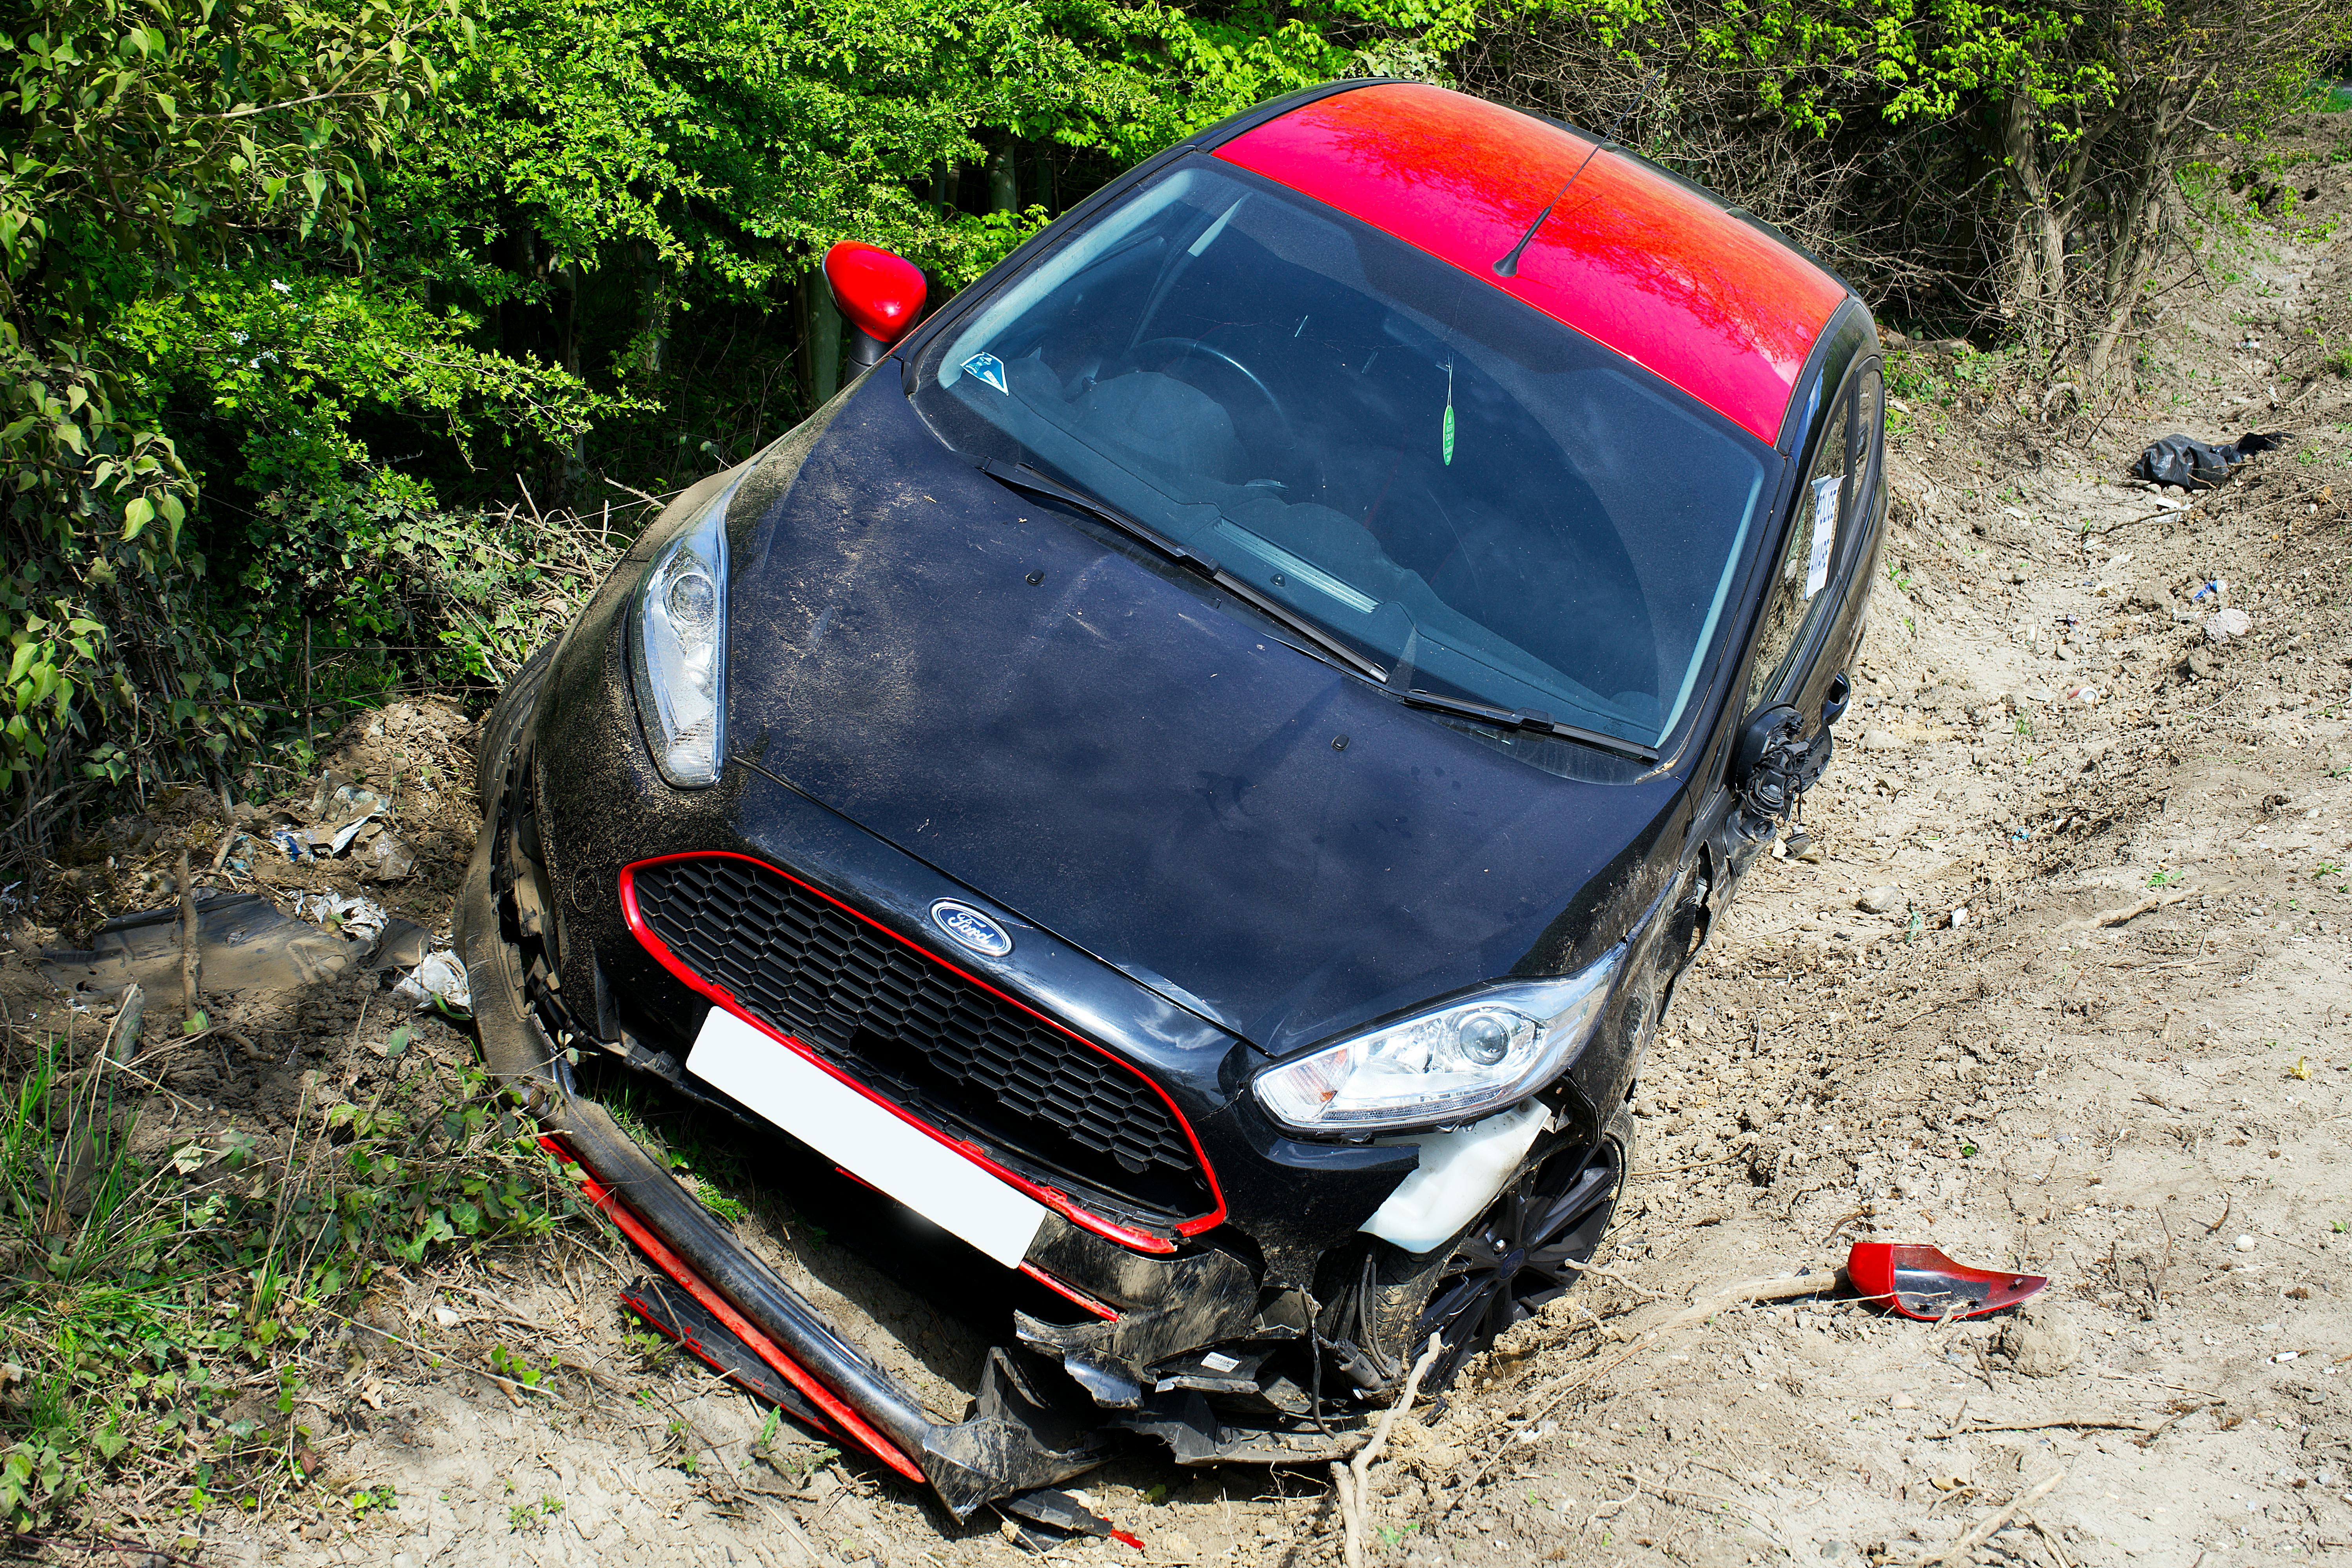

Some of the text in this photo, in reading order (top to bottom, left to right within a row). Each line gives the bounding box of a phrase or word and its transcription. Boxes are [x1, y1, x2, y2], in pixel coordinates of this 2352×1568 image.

[1815, 489, 1837, 527] POLICE
[1808, 539, 1829, 578] AWARE
[948, 912, 995, 945] Ford
